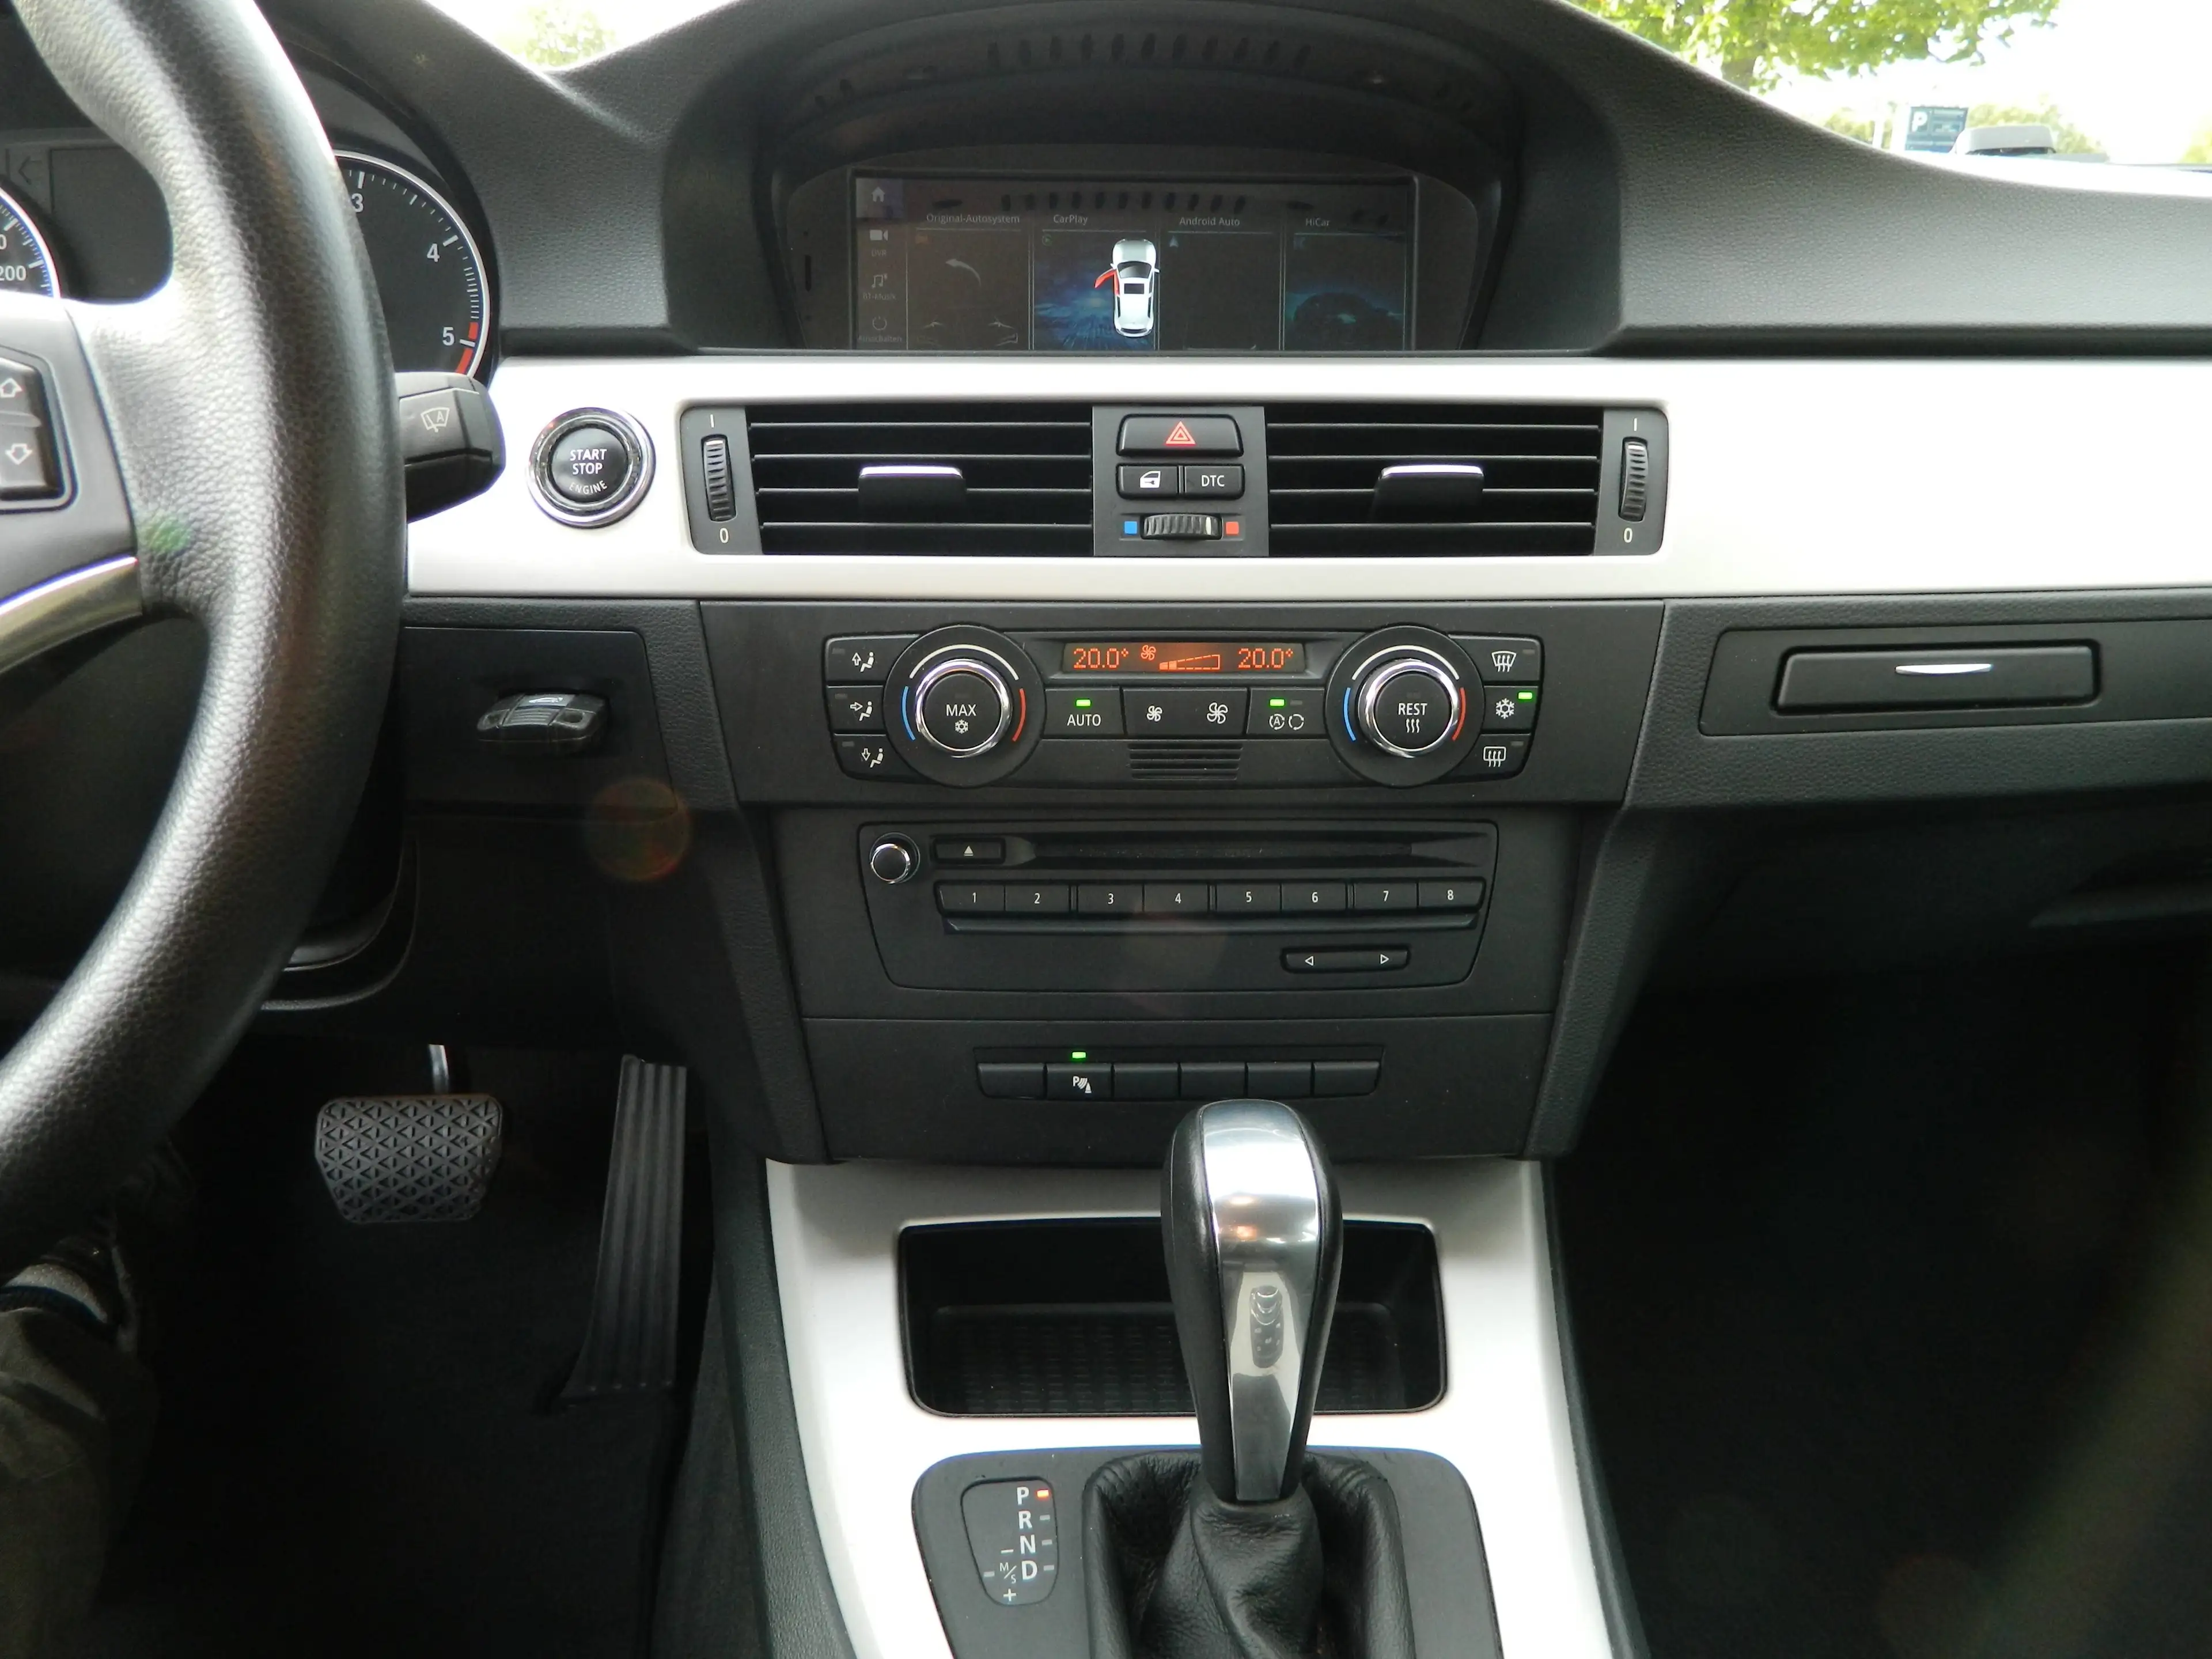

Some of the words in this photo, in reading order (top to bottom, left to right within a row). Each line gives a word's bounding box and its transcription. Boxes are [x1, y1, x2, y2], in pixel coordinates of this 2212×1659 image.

[1911, 111, 1927, 132] P
[351, 193, 364, 213] 3
[926, 214, 1020, 224] Original-Autosystem
[1053, 214, 1088, 226] CarPlay
[1179, 216, 1216, 226] Android
[1218, 217, 1240, 226] Auto
[1305, 217, 1330, 227] HiCar
[426, 243, 440, 262] 4
[442, 327, 454, 346] 5
[570, 448, 607, 461] START
[572, 463, 603, 475] STOP
[1201, 475, 1225, 487] DTC
[569, 480, 608, 495] ENGINE
[946, 704, 976, 717] MAX
[1398, 703, 1427, 715] REST
[1067, 714, 1101, 726] AUTO
[972, 892, 976, 903] 1
[1034, 893, 1040, 904] 2
[1108, 893, 1114, 904] 3
[1175, 893, 1181, 904] 4
[1246, 891, 1252, 903] 5
[1312, 892, 1319, 903] 6
[1383, 891, 1389, 902] 7
[1447, 889, 1454, 900] 8
[1017, 1487, 1029, 1505] P
[1018, 1510, 1032, 1529] R
[1020, 1534, 1036, 1554] N
[1021, 1560, 1037, 1580] D
